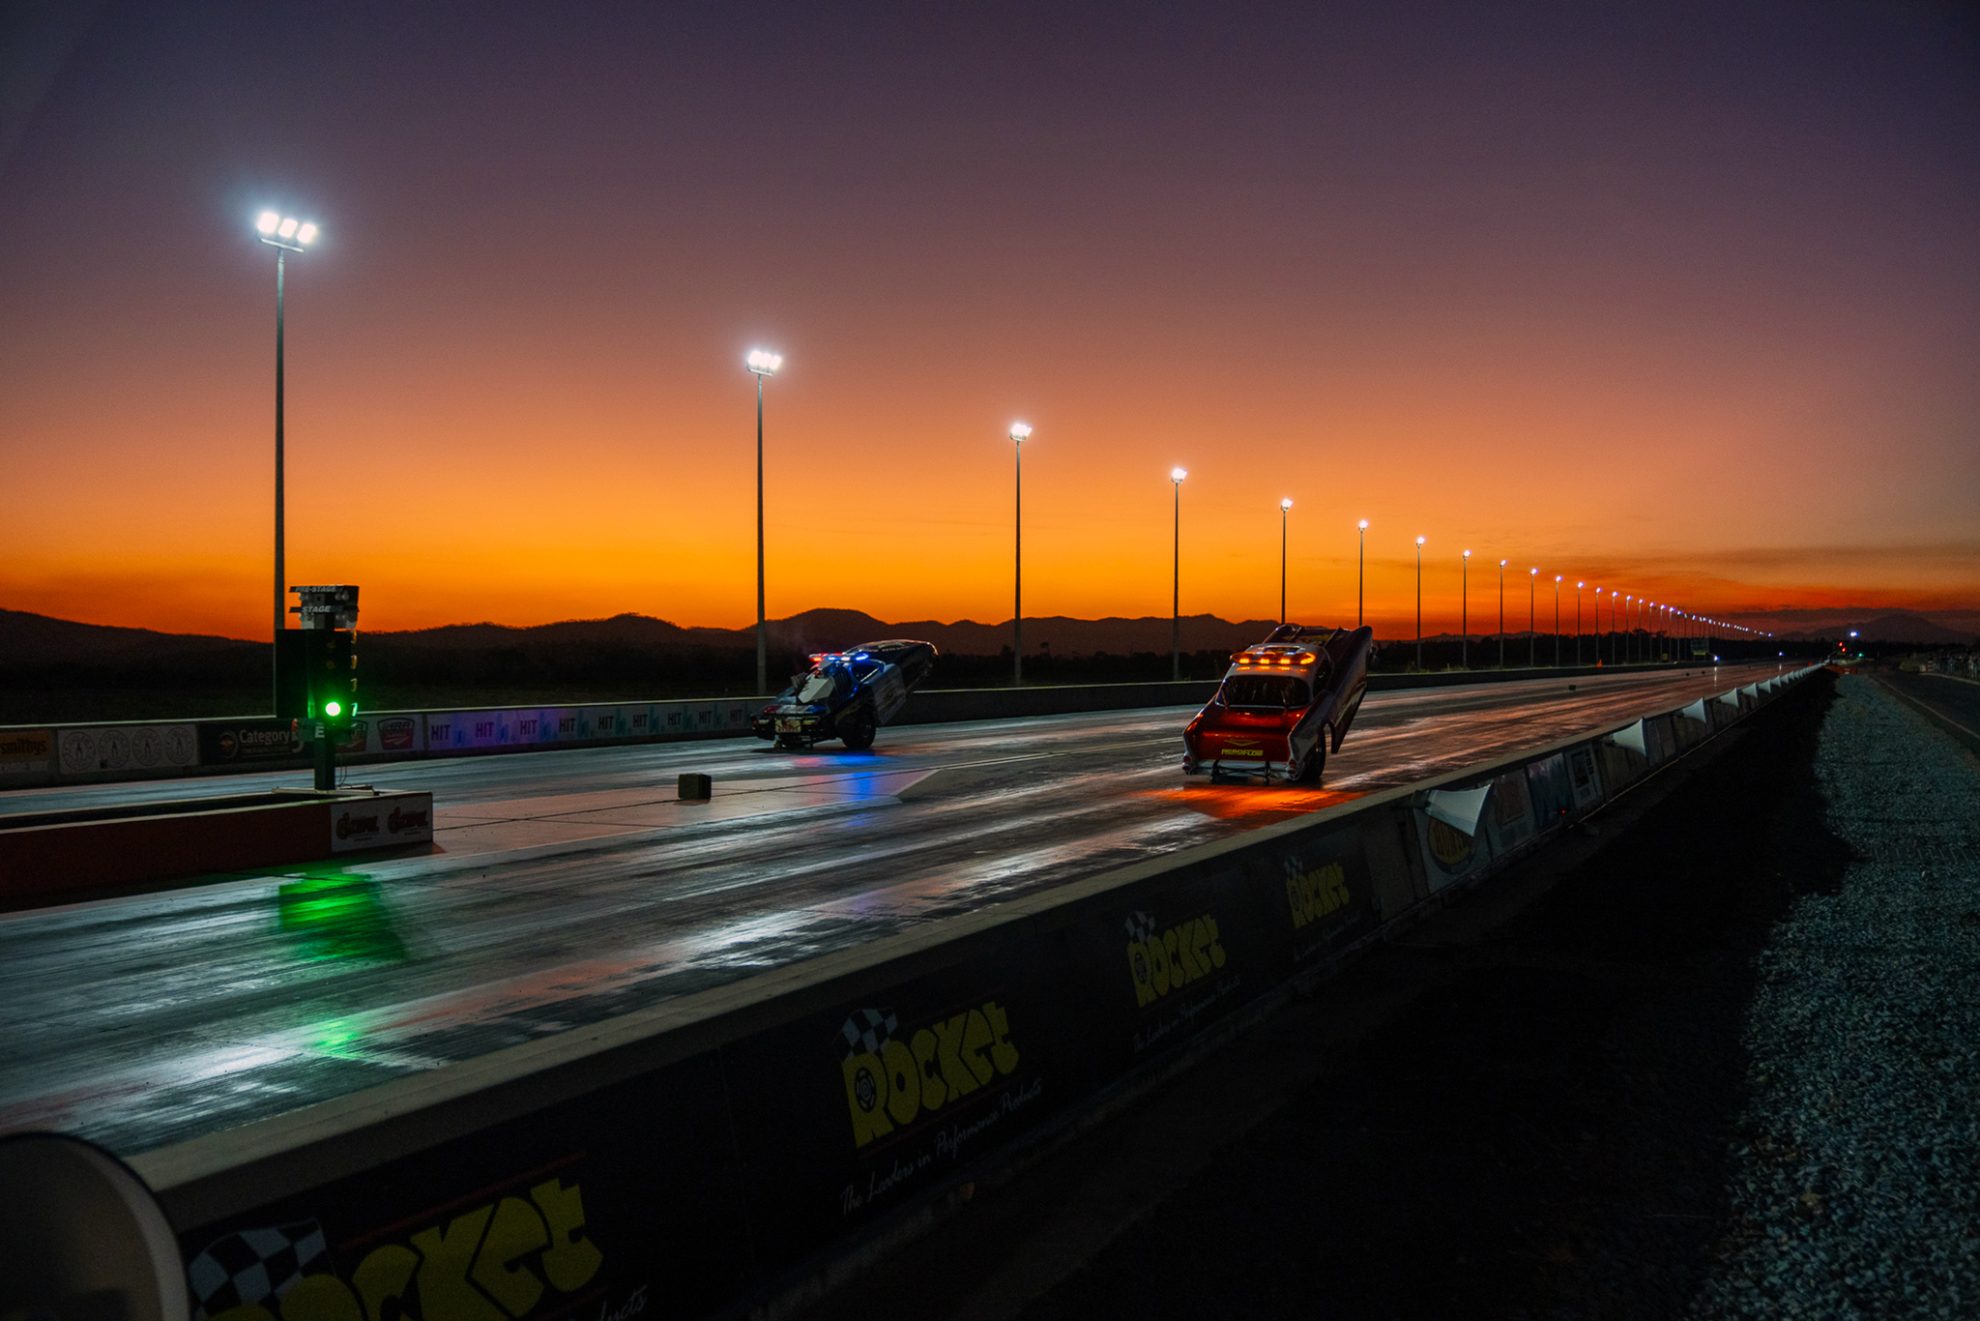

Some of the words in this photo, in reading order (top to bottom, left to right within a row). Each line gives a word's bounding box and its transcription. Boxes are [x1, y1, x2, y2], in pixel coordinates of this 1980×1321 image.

[302, 605, 332, 613] STAGE
[633, 714, 648, 727] HIT
[668, 712, 682, 725] HIT
[699, 711, 712, 724] HIT
[730, 709, 744, 721] HIT
[475, 722, 495, 738] HIT
[520, 719, 538, 735] HIT
[559, 717, 576, 732] HIT
[599, 716, 614, 730] HIT
[239, 729, 290, 745] Category
[431, 724, 451, 740] HIT
[840, 1183, 863, 1216] The
[867, 1158, 914, 1203] Leaders
[916, 1154, 932, 1169] in
[935, 1122, 999, 1159] Performance
[1001, 1076, 1042, 1117] Products
